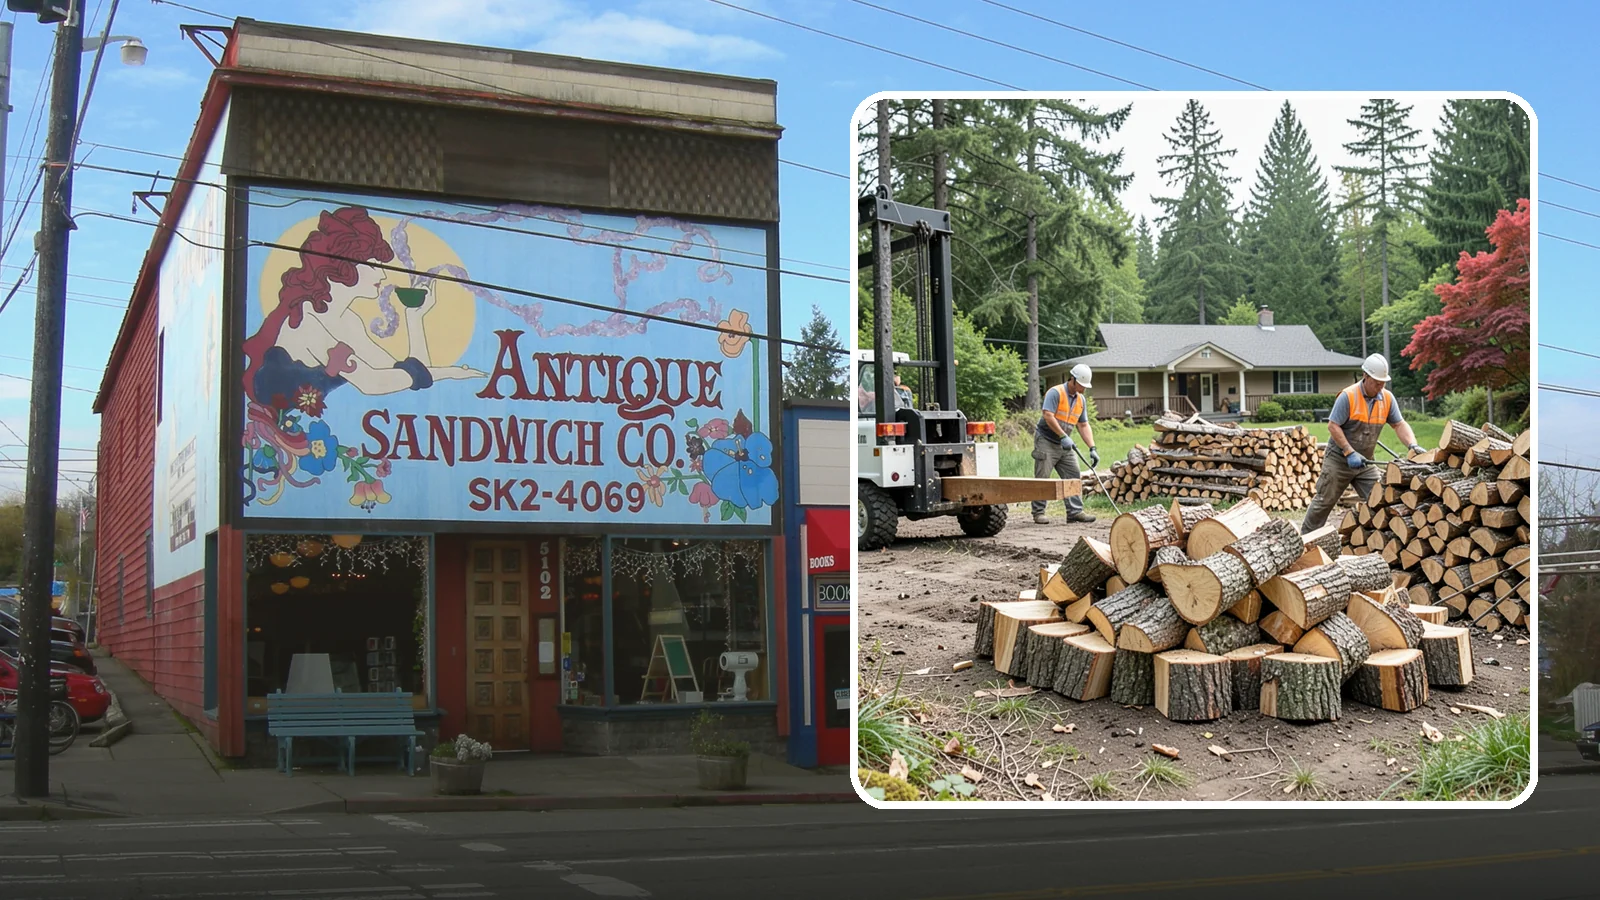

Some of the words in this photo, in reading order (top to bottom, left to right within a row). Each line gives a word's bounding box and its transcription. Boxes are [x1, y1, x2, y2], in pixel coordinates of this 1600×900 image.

[475, 328, 724, 421] ANTIQUE
[361, 408, 604, 467] SANDWICH
[617, 422, 685, 469] CO.
[468, 476, 646, 513] SK2-4069
[539, 541, 552, 600] 5102
[809, 554, 835, 569] BOOKS
